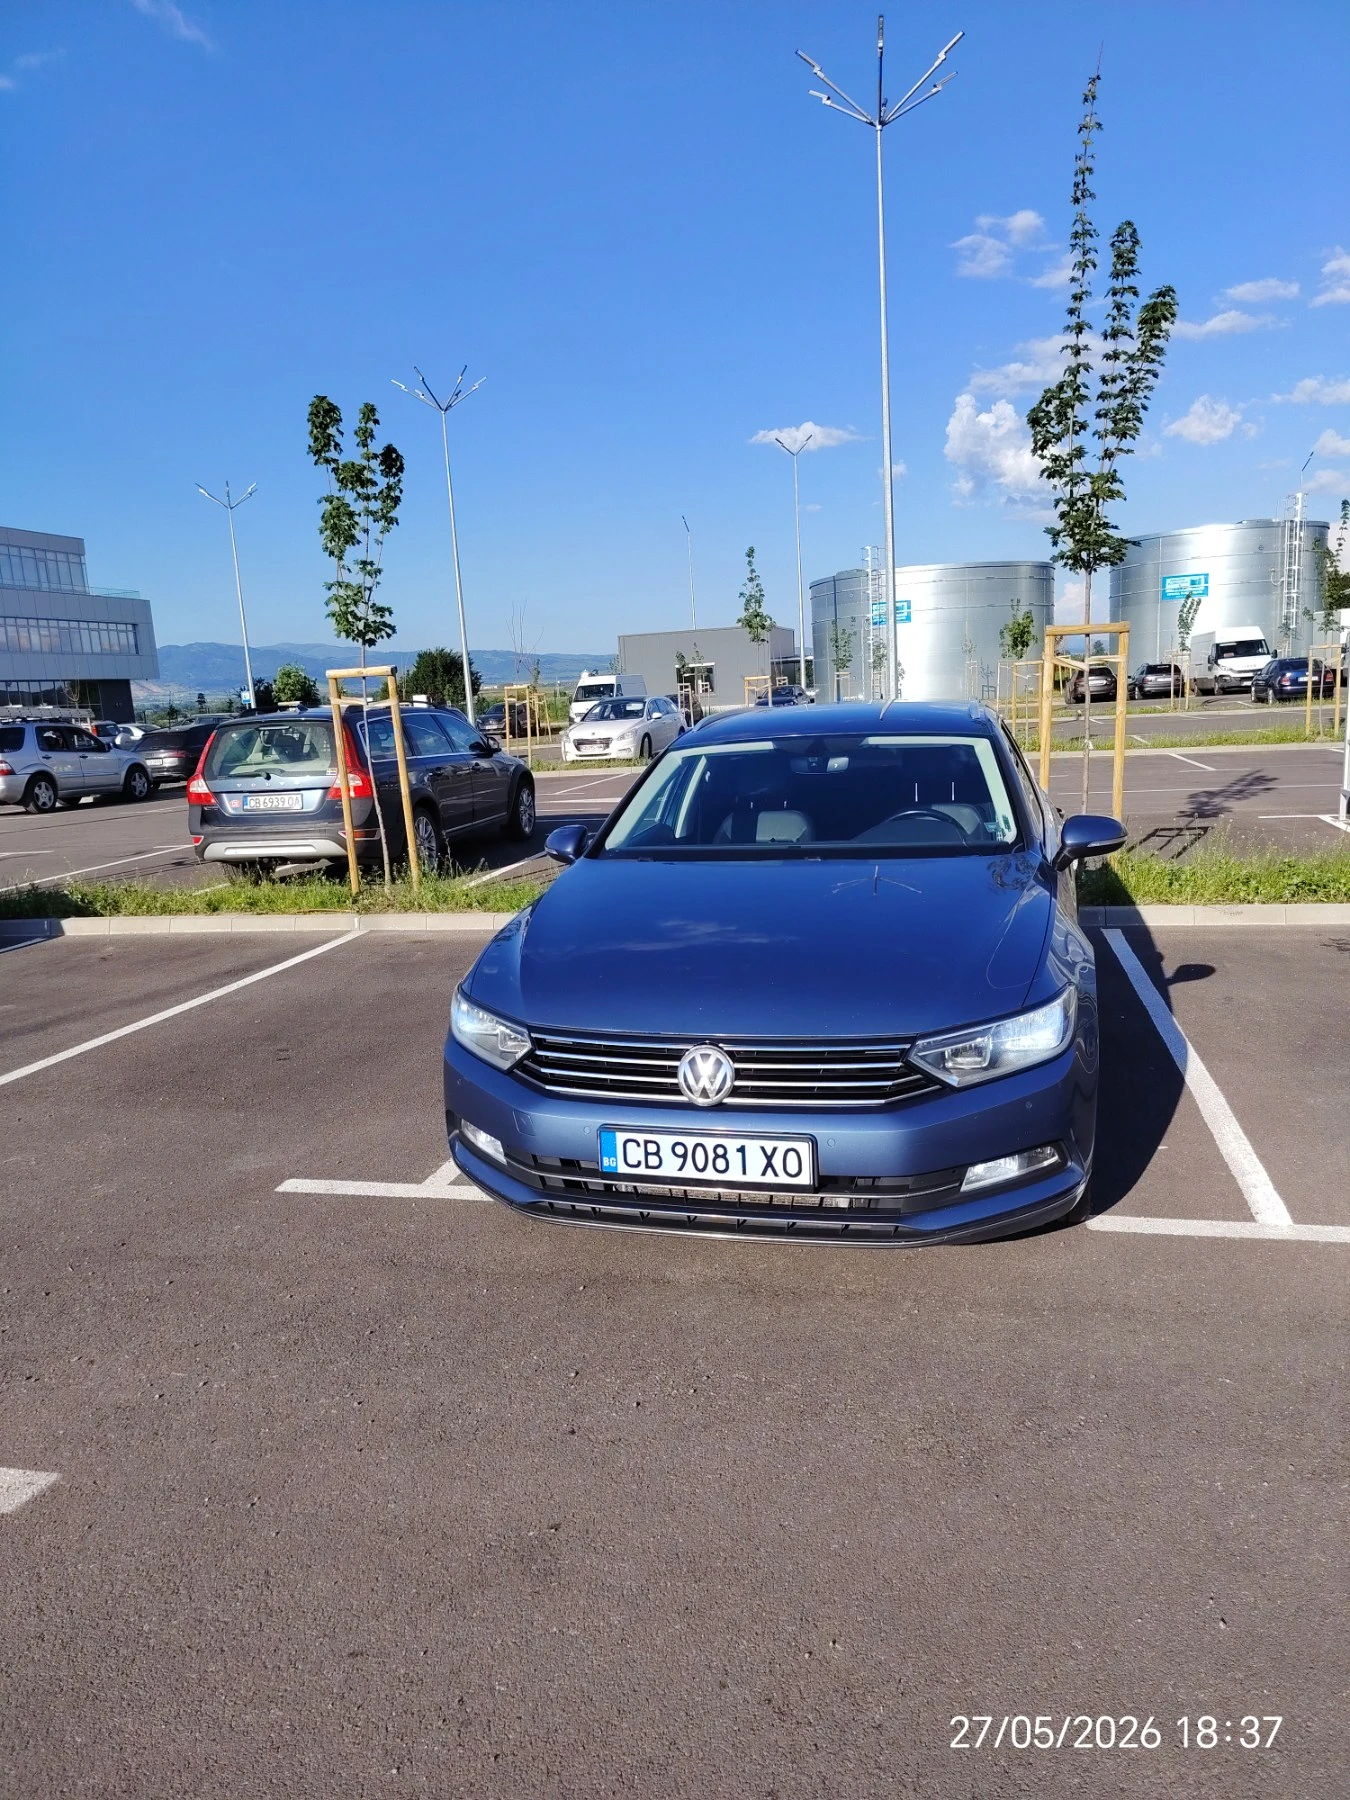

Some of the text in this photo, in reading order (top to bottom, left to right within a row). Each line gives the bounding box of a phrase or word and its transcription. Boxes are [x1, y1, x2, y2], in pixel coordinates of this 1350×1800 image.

[248, 797, 261, 808] CB
[262, 796, 286, 808] 6939
[681, 1049, 731, 1102] VW
[602, 1156, 617, 1167] BG
[622, 1138, 803, 1179] CB 9081 XO
